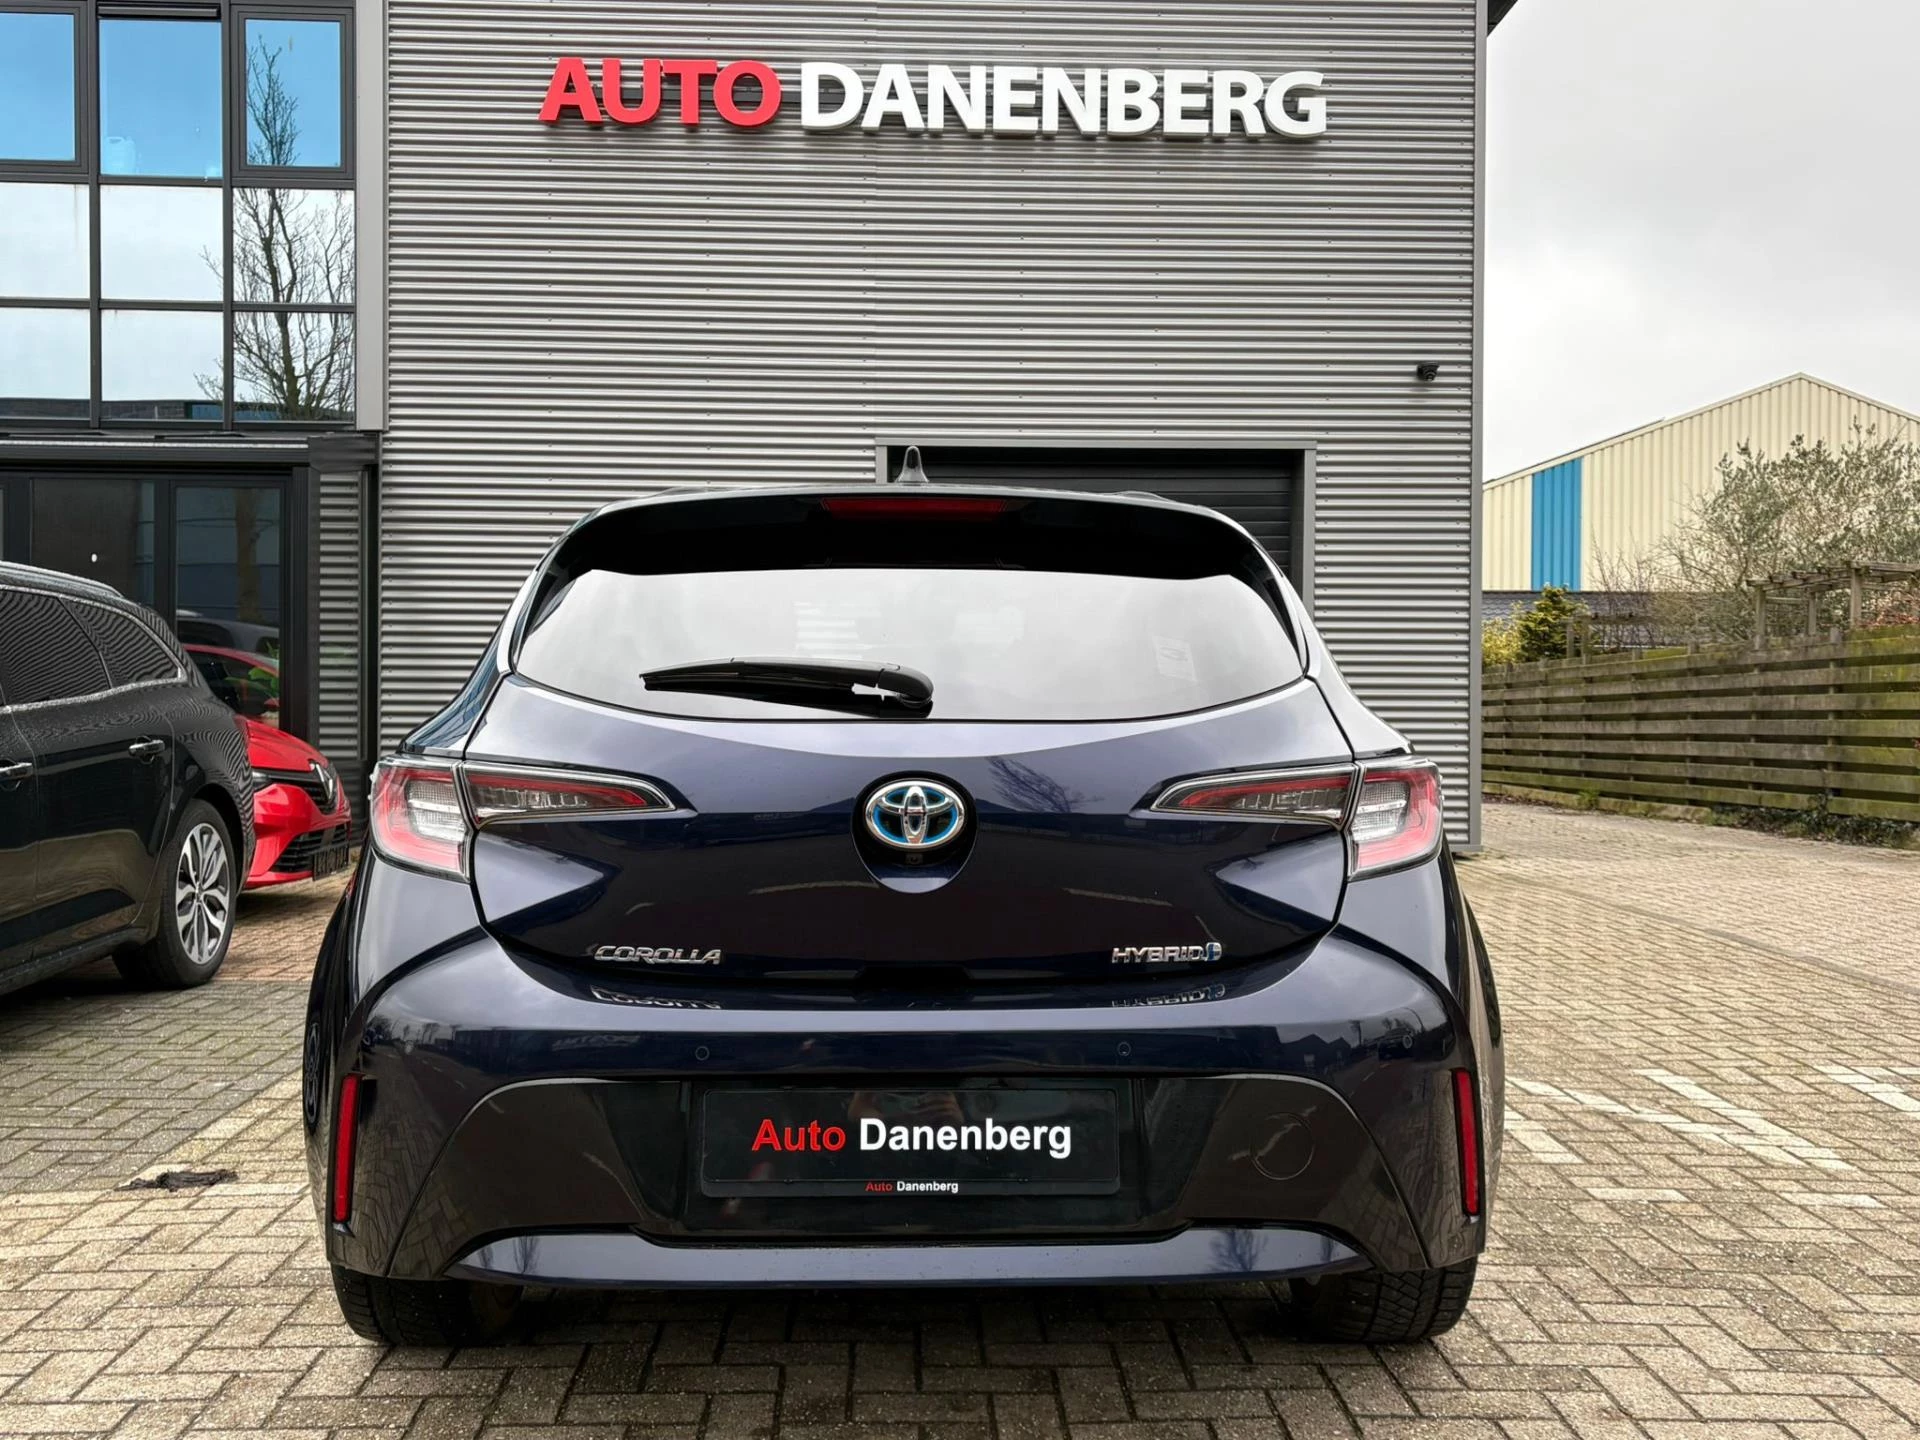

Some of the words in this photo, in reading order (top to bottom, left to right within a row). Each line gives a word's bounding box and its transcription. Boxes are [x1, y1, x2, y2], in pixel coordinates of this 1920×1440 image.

[540, 56, 782, 128] AUTO
[799, 61, 1328, 138] DANENBERG
[593, 945, 722, 965] COROLLA
[1111, 945, 1207, 964] HYBRID
[751, 1118, 847, 1152] Auto
[859, 1117, 1072, 1159] Danenberg
[865, 1181, 893, 1193] Auto
[896, 1181, 960, 1193] Danenberg
